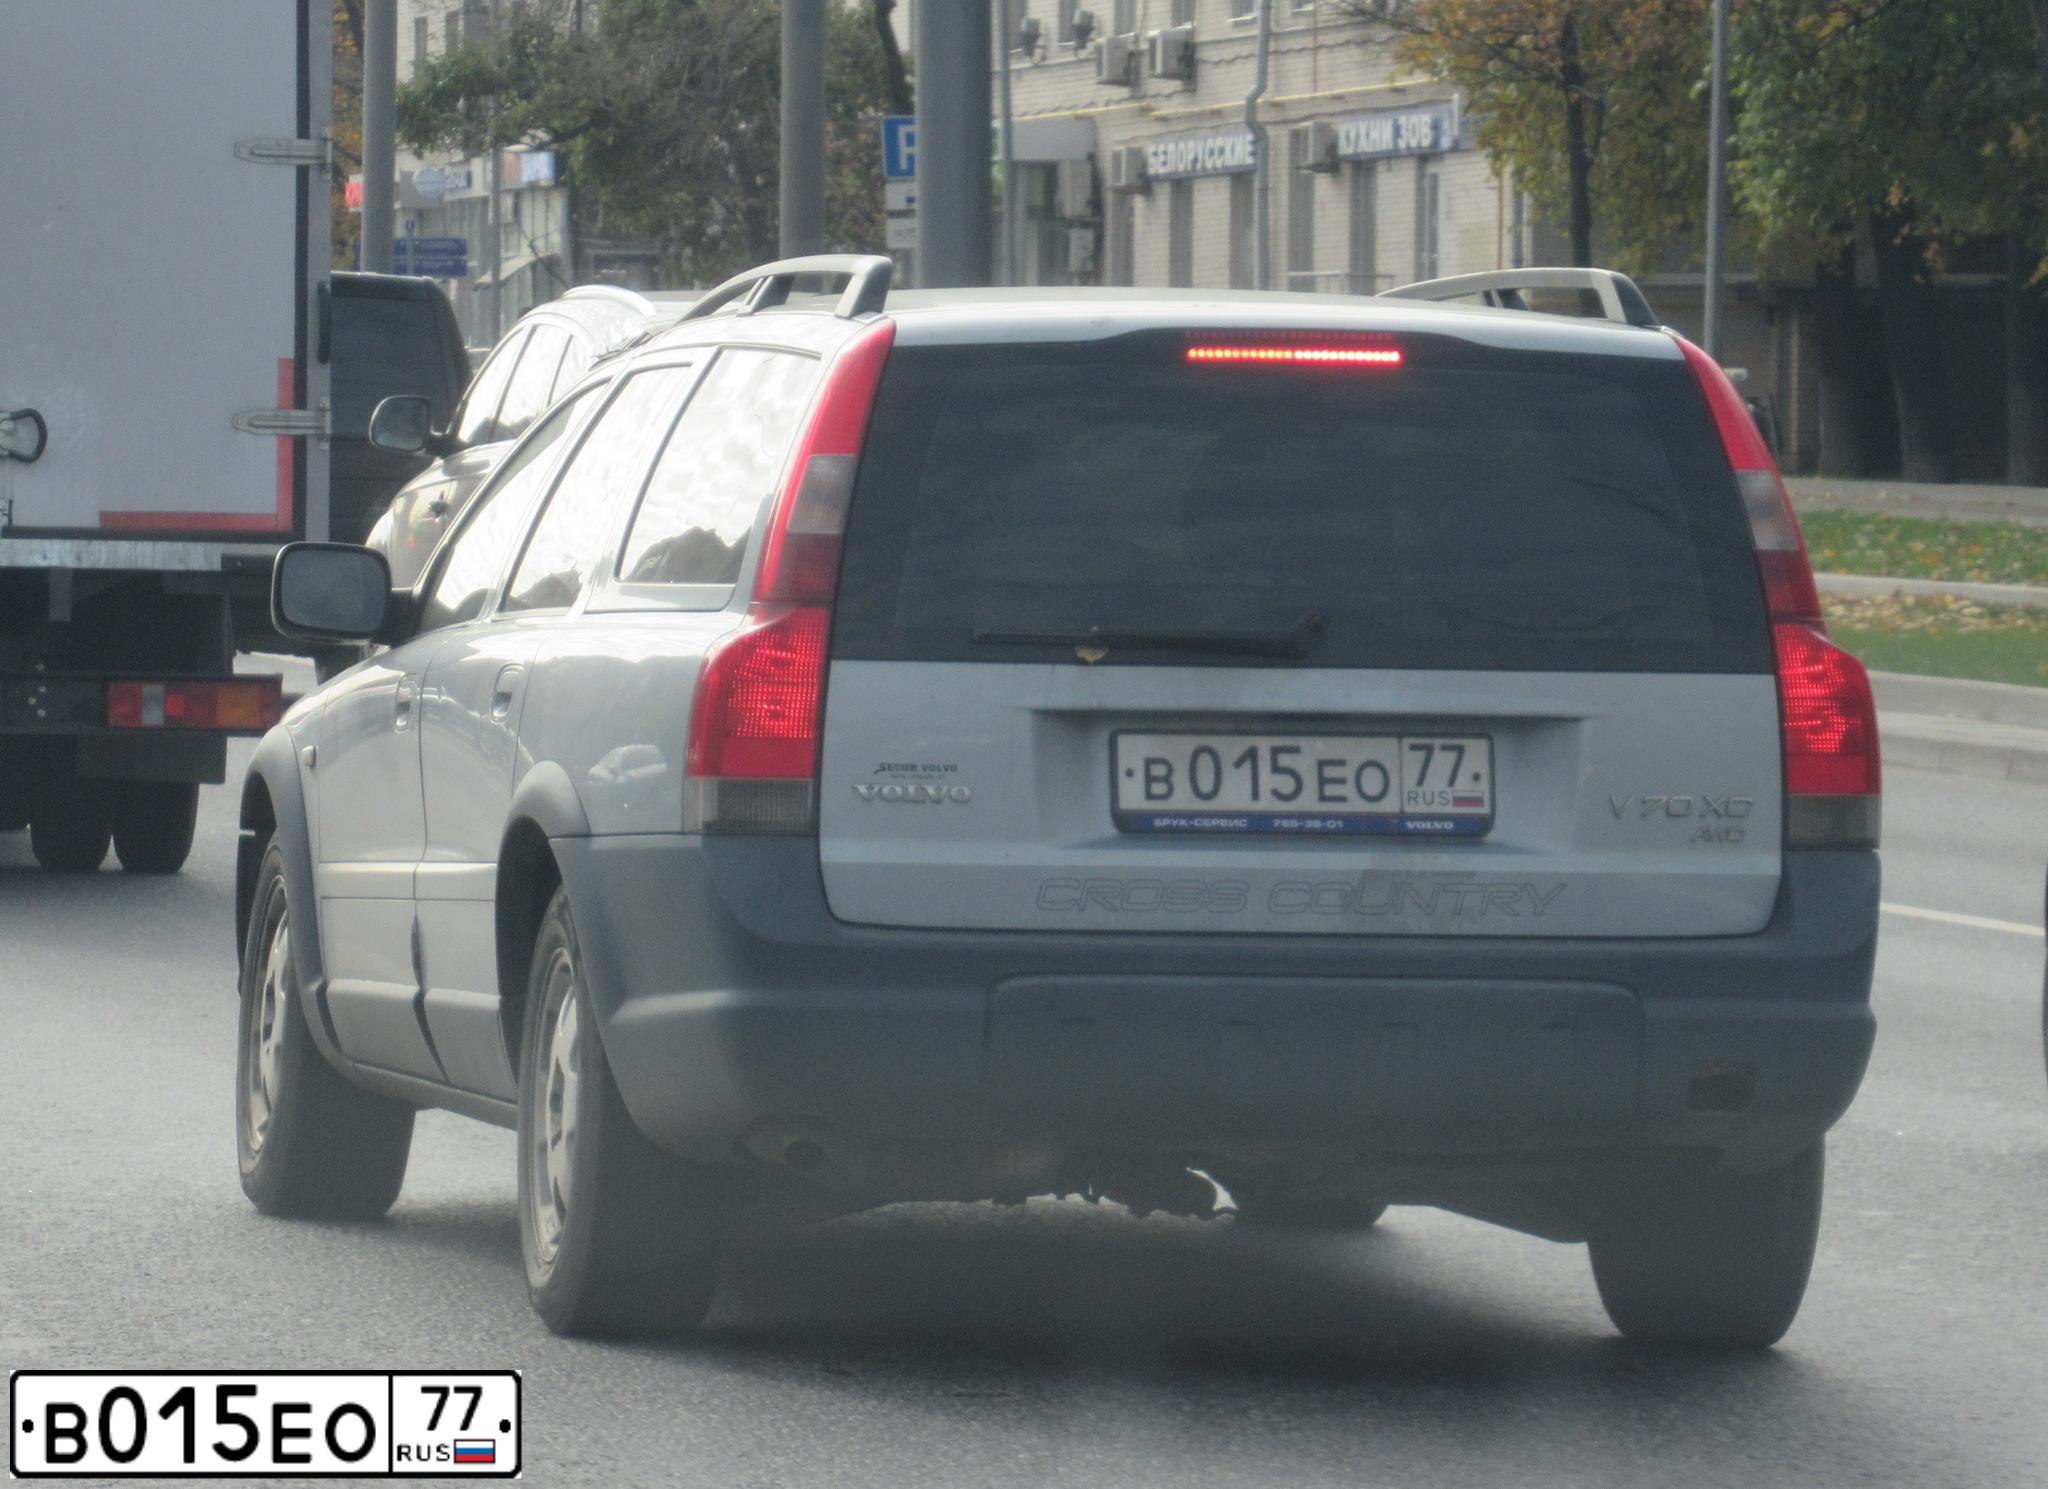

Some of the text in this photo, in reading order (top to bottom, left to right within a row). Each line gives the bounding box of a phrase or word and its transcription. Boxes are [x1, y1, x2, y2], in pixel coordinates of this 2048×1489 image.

[1398, 114, 1432, 148] ЗОВ
[1148, 133, 1254, 174] БЕЛОРУССКИЕ
[921, 763, 958, 773] VOLVO
[1408, 743, 1466, 788] 77
[852, 783, 973, 804] VOLVO
[1407, 790, 1451, 806] RUS
[1405, 821, 1454, 830] VOLVO
[1036, 877, 1567, 917] CROSS COUNTRY
